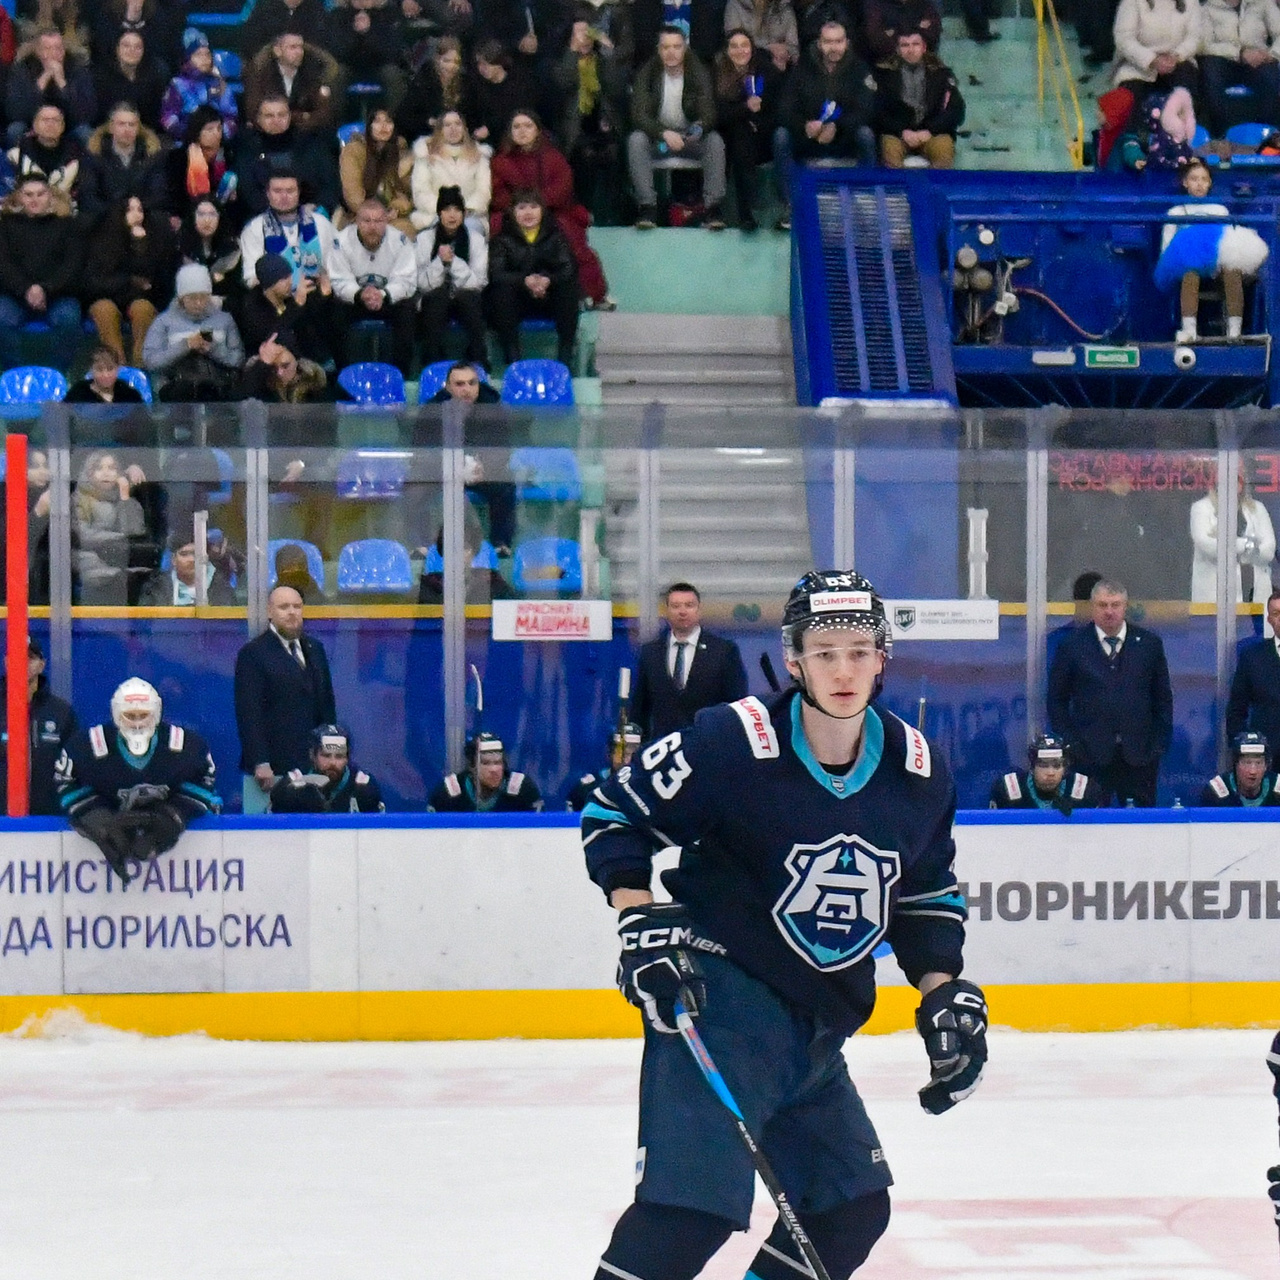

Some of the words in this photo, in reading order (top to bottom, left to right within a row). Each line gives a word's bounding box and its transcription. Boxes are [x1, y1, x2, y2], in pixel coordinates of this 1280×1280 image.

[813, 597, 868, 606] OLIMPBET
[642, 732, 693, 799] 63
[66, 914, 292, 949] НОРИЛЬСКА
[621, 926, 692, 950] CCM
